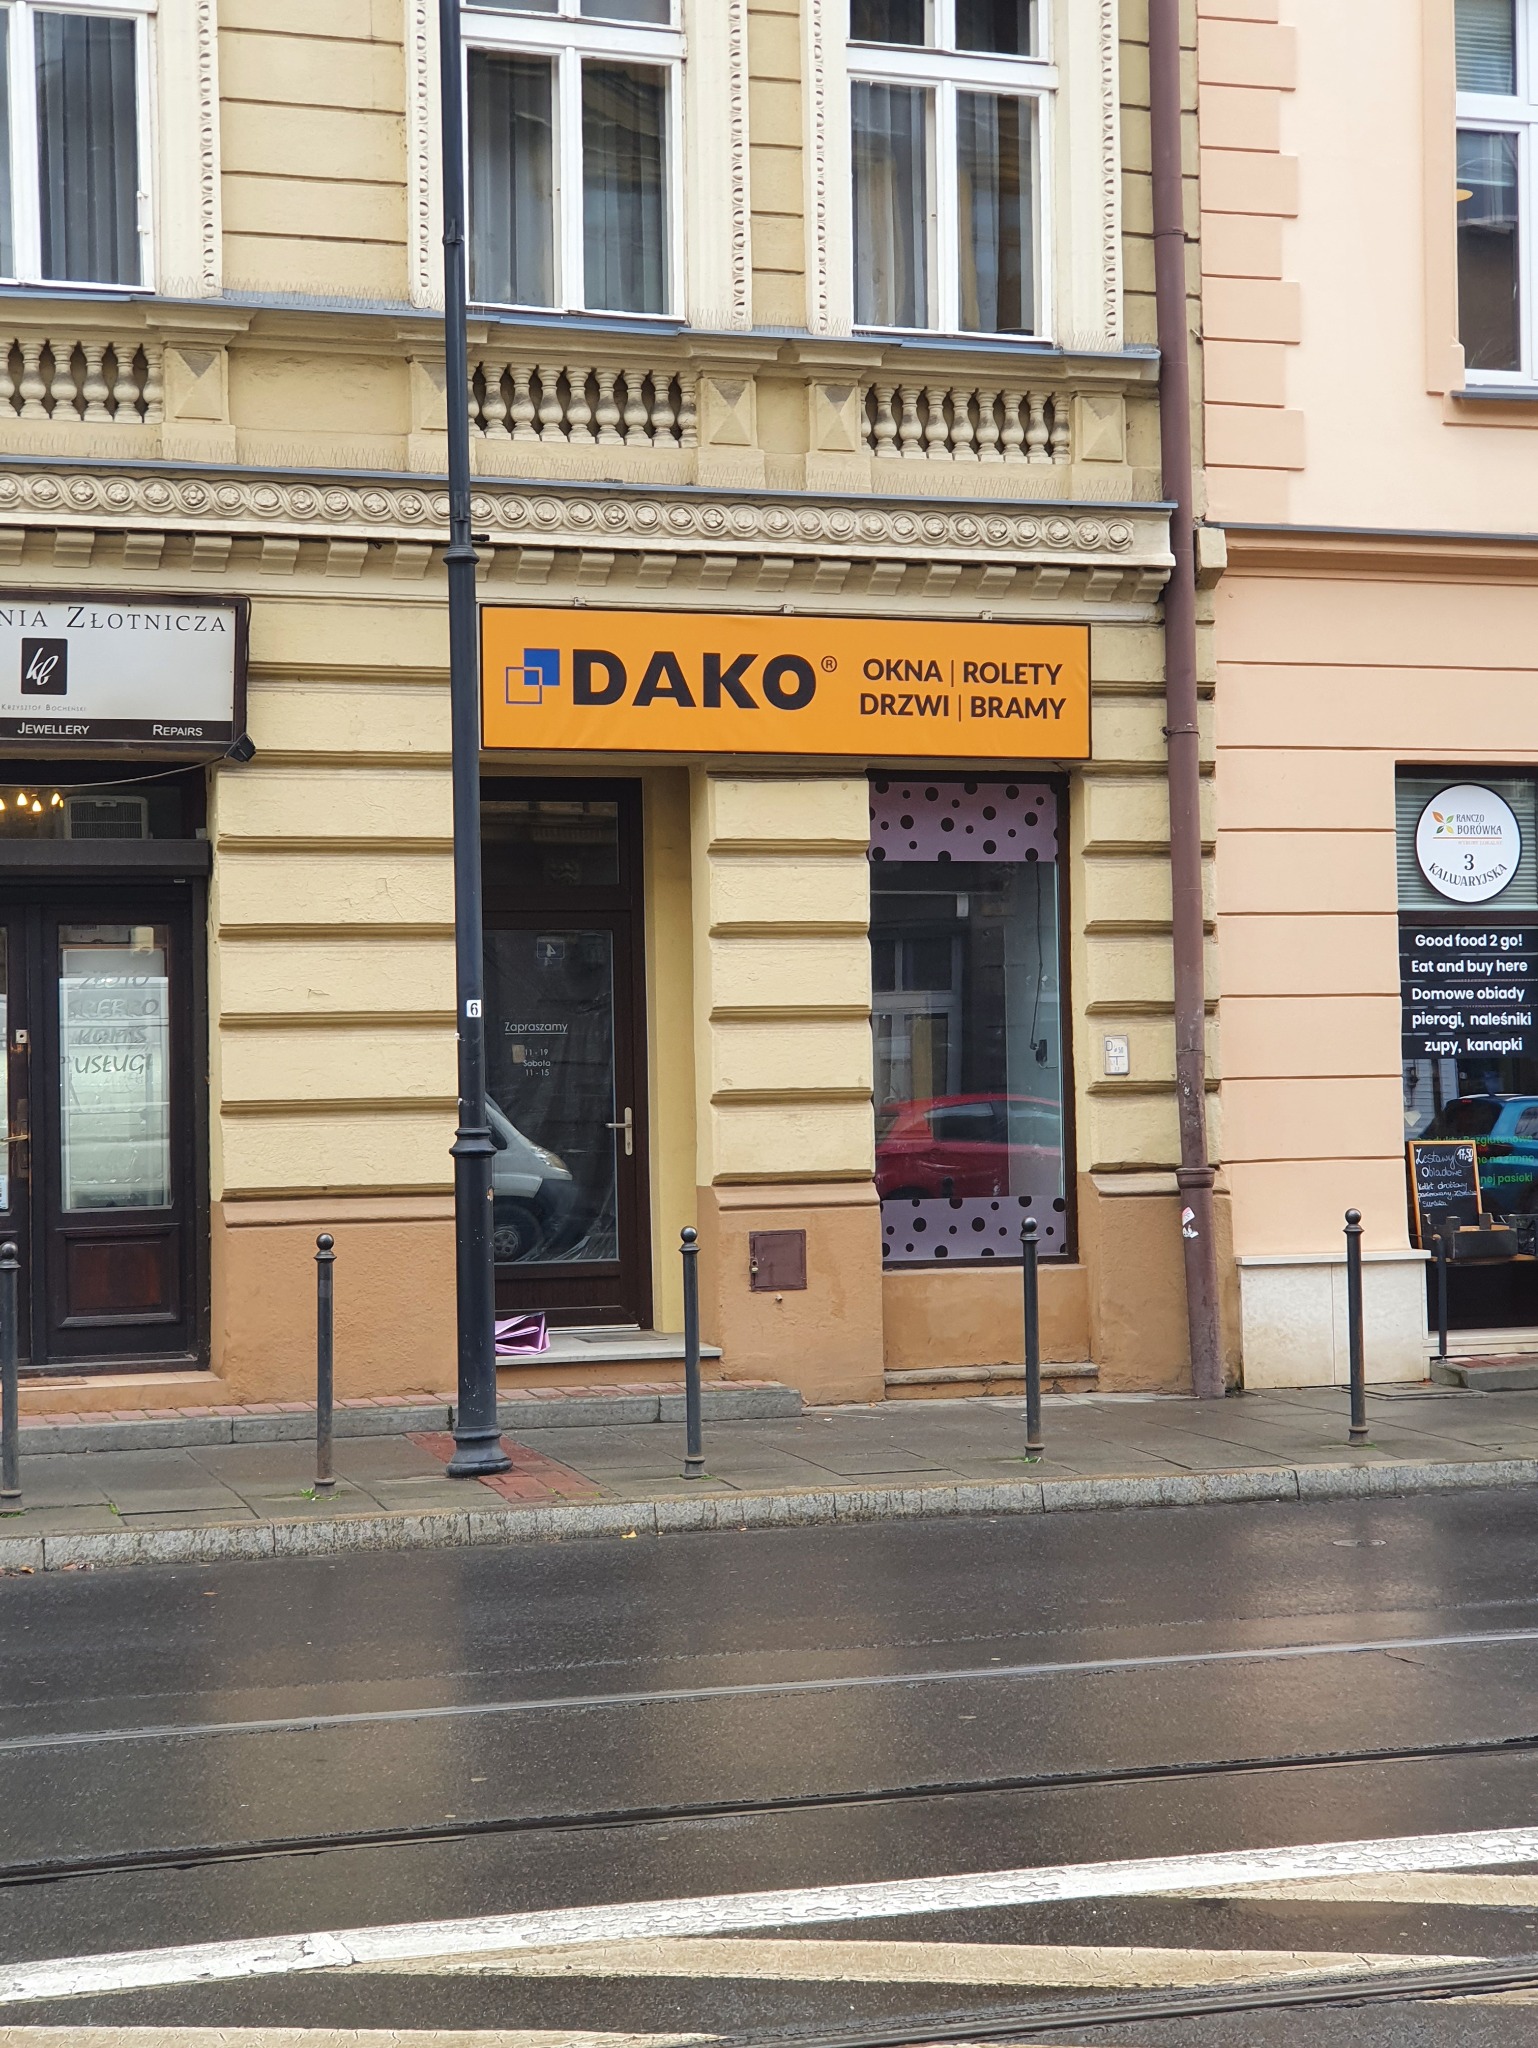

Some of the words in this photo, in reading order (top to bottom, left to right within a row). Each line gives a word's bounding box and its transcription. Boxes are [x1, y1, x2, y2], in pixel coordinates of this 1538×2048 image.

[66, 606, 226, 632] ZŁOTNICZA
[863, 658, 943, 682] OKNA
[963, 661, 1063, 686] ROLETY
[860, 692, 949, 717] DRZWI
[970, 695, 1067, 720] BRAMY
[17, 722, 90, 736] JEWELLERY
[152, 724, 203, 737] REPAIRS
[1456, 813, 1485, 823] RANCZO
[1457, 822, 1502, 835] BORÓWKA
[1463, 853, 1475, 871] 3
[1428, 862, 1508, 887] KALWARYJSKA
[1415, 934, 1453, 947] Good
[1455, 933, 1487, 947] food
[1489, 934, 1498, 947] 2
[1500, 933, 1523, 951] go!
[1411, 960, 1434, 973] Eat
[1436, 960, 1464, 973] and
[1467, 960, 1494, 976] buy
[1496, 960, 1528, 972] here
[1411, 988, 1474, 1000] Domowe
[1477, 986, 1525, 1002] obiady
[470, 1002, 479, 1016] 6
[504, 1021, 568, 1034] Zapraszamy
[1412, 1011, 1465, 1029] pierogi,
[1470, 1012, 1532, 1025] naleśniki
[1424, 1041, 1462, 1055] zupy,
[1467, 1037, 1523, 1055] kanapki
[1415, 1148, 1456, 1170] Zestawy
